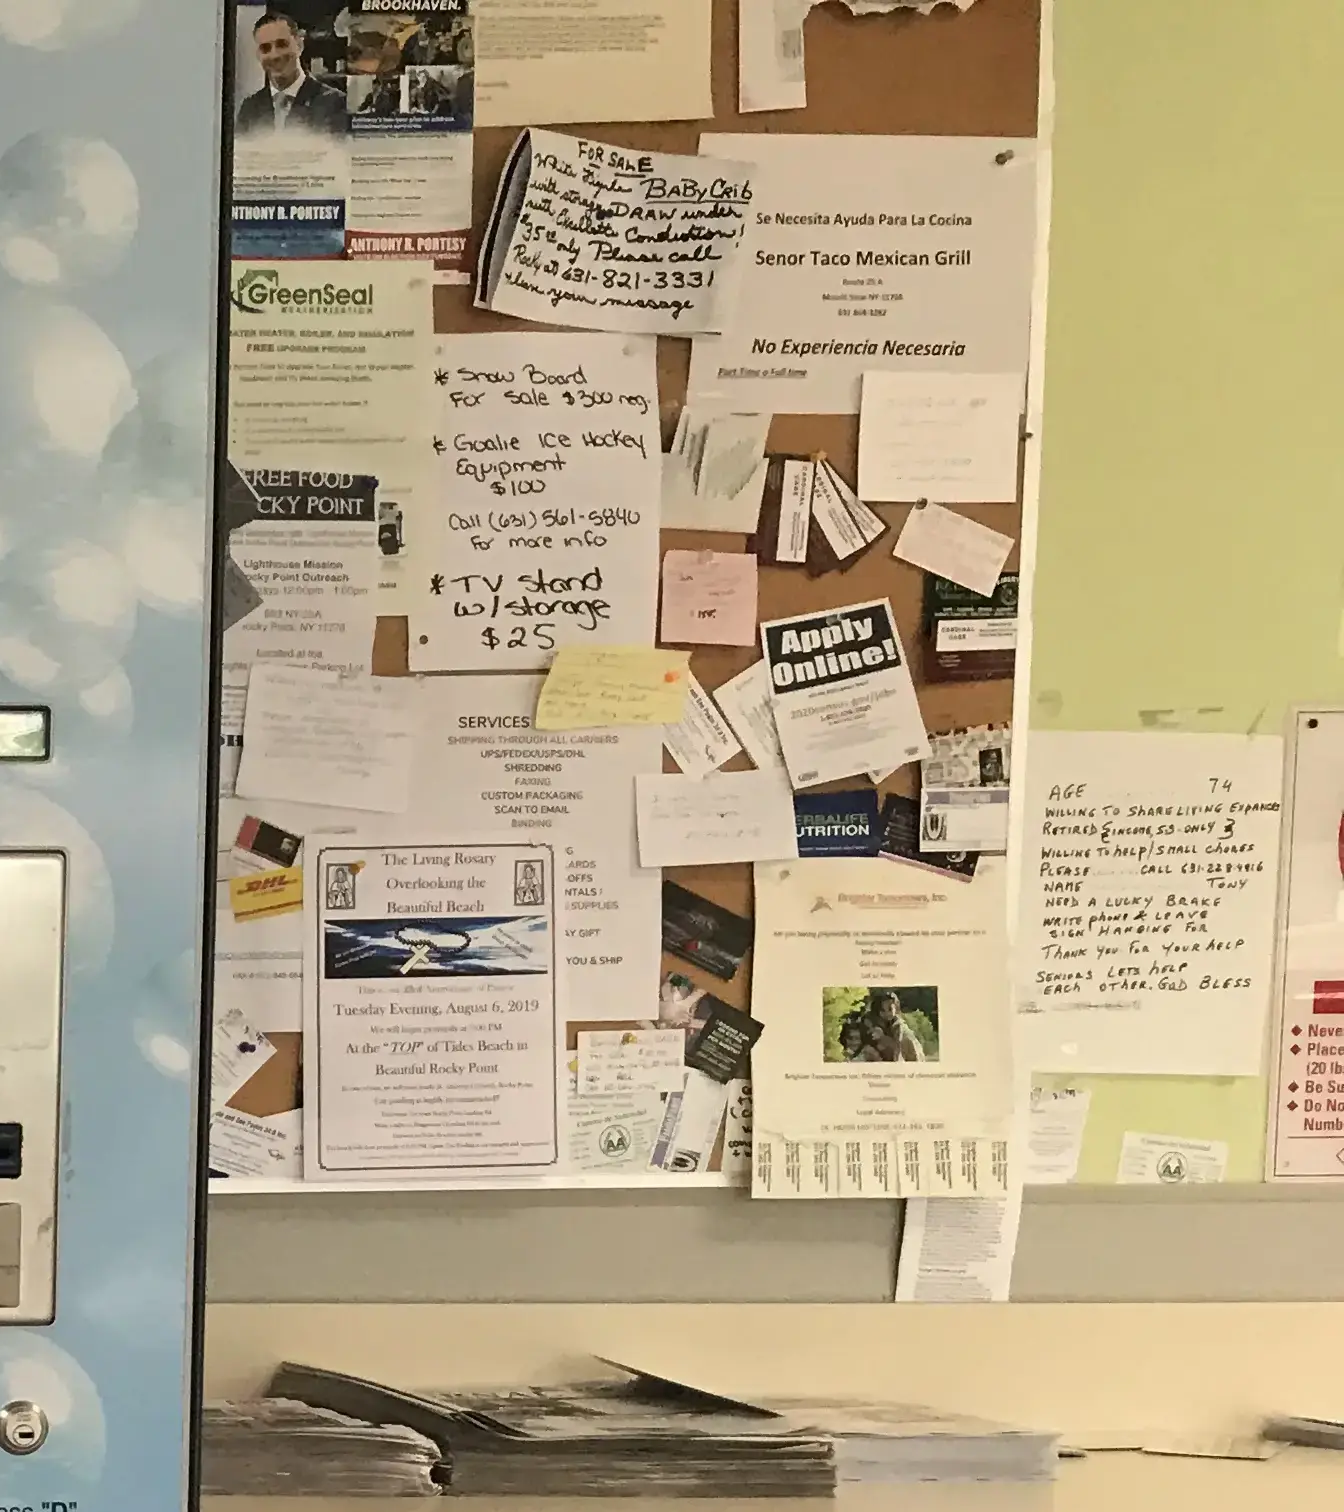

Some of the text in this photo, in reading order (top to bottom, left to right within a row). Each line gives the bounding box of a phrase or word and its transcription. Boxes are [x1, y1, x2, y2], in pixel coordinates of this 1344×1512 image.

[578, 142, 604, 162] FOR
[290, 206, 340, 220] PORTESY
[756, 213, 972, 228] Se Necesita Ayuda Para La Cocina
[350, 237, 467, 252] ANTHONY PORTESY
[756, 250, 971, 266] Senor Taco Mexican Grill
[562, 268, 714, 291] 631-821-3331
[248, 283, 373, 305] GreenSeal
[752, 339, 966, 360] No Experiencia Necesaria
[457, 364, 587, 385] Snow Board
[504, 390, 613, 408] Sale $300
[456, 453, 566, 482] Equipment
[298, 471, 353, 489] FOOD
[491, 480, 546, 496] $100
[307, 497, 364, 515] POINT
[449, 510, 537, 533] Call (631)
[509, 536, 553, 548] more
[303, 560, 344, 569] Mission
[273, 573, 350, 582] Point Outreach
[450, 574, 504, 593] TV
[480, 623, 555, 651] $25
[781, 617, 874, 656] Apply
[772, 639, 898, 687] Online!
[458, 716, 530, 728] SERVICES
[498, 736, 568, 744] THROUGH ALL
[504, 763, 562, 772] SHREDDING
[515, 777, 551, 786] FAXING
[1049, 778, 1232, 800] AGE 74
[481, 791, 584, 800] CUSTOM PACKAGING
[494, 805, 570, 814] SCAN TO EMAIL
[1045, 806, 1096, 818] WILLING
[1043, 822, 1098, 836] RETIRED
[381, 852, 496, 867] The Living Rosary
[1040, 863, 1173, 877] PLEASE CALL
[386, 877, 487, 892] Overlooking the
[1044, 881, 1084, 893] NAME
[386, 900, 485, 913] Beautiful Beach
[1106, 895, 1222, 908] LUCKY BRAKE
[566, 956, 623, 965] YOU SHIP
[1199, 977, 1252, 989] BLESS
[333, 999, 540, 1018] Tuesday Evening, August 2019
[427, 1040, 513, 1052] of Tides Beach
[375, 1063, 498, 1077] Beautiful Rocky Point
[1307, 1061, 1327, 1076] (20
[1305, 1080, 1325, 1093] Be
[1304, 1099, 1322, 1112] Do
